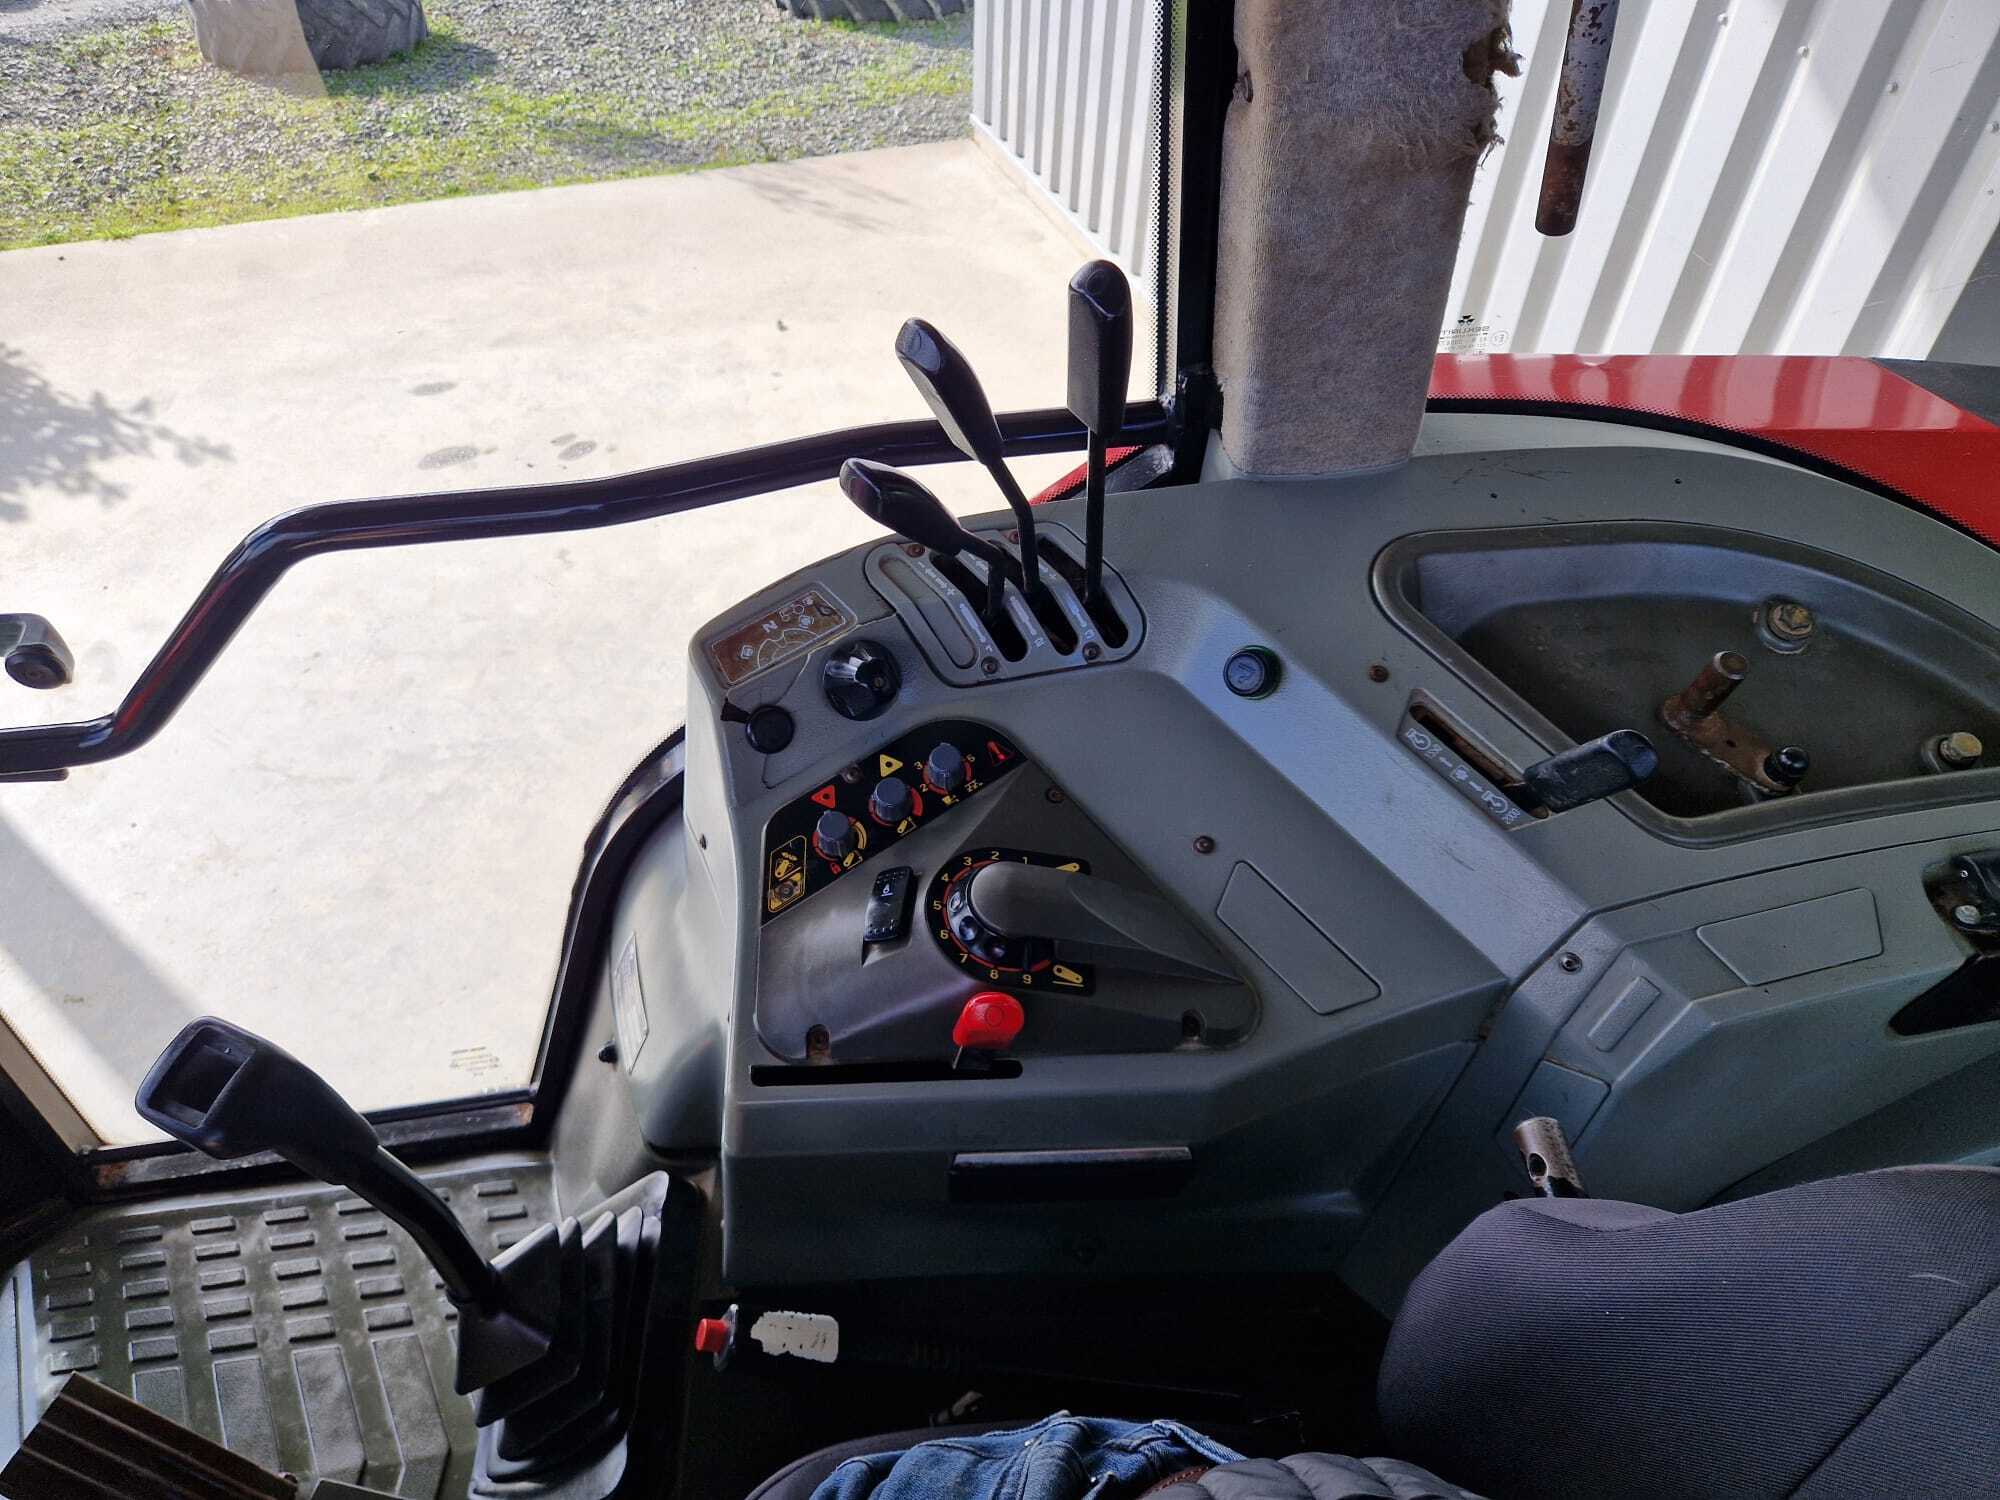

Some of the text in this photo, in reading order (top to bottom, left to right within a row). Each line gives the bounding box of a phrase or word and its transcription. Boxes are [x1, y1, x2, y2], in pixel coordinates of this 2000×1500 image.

[762, 620, 778, 633] N
[913, 761, 923, 770] 3
[920, 783, 929, 793] 2
[991, 851, 1000, 860] 2
[1022, 856, 1029, 865] 1
[963, 857, 972, 866] 3
[941, 872, 950, 882] 4
[933, 901, 942, 911] 5
[940, 930, 949, 939] 6
[960, 953, 968, 963] 7
[990, 969, 999, 979] 8
[1022, 974, 1032, 984] 9
